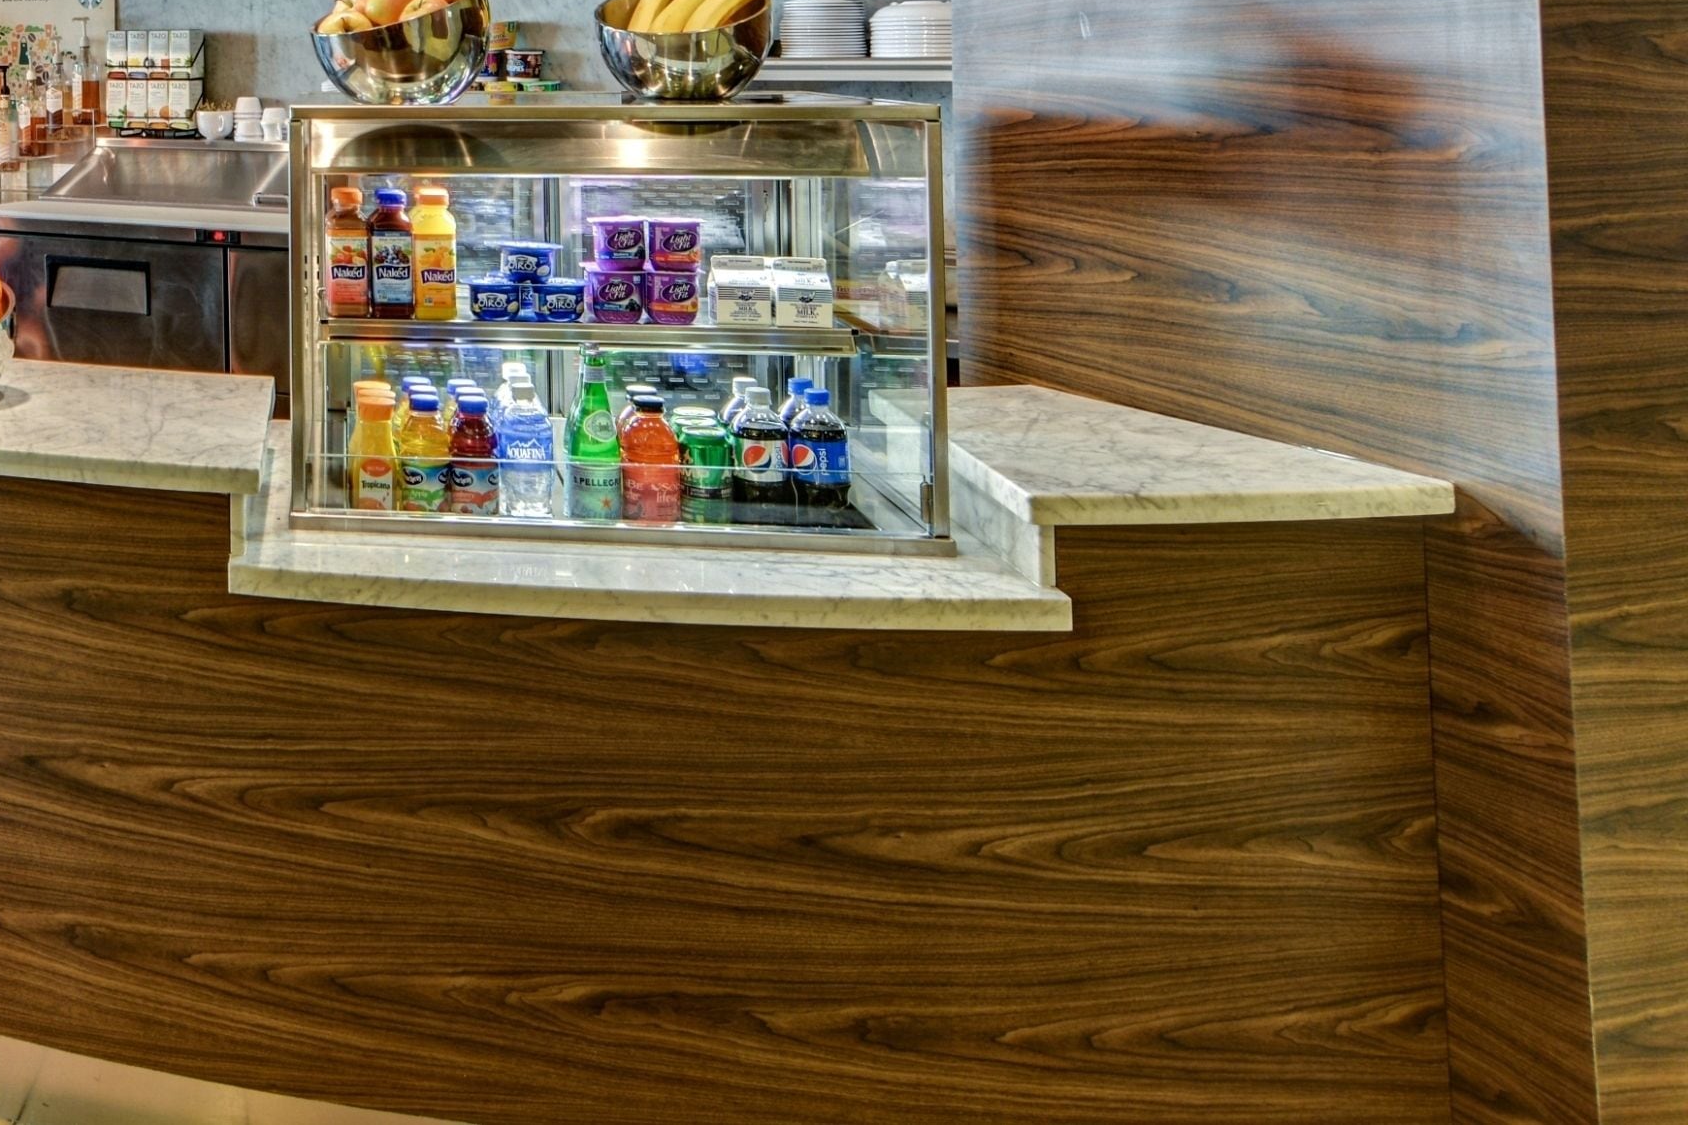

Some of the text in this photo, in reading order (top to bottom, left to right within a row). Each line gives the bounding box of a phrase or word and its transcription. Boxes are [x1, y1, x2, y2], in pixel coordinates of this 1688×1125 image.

[614, 231, 635, 243] Light
[670, 233, 692, 244] Light
[605, 283, 627, 296] Light
[669, 283, 690, 296] Light
[817, 448, 830, 475] pepsi
[362, 480, 390, 489] Tropicana
